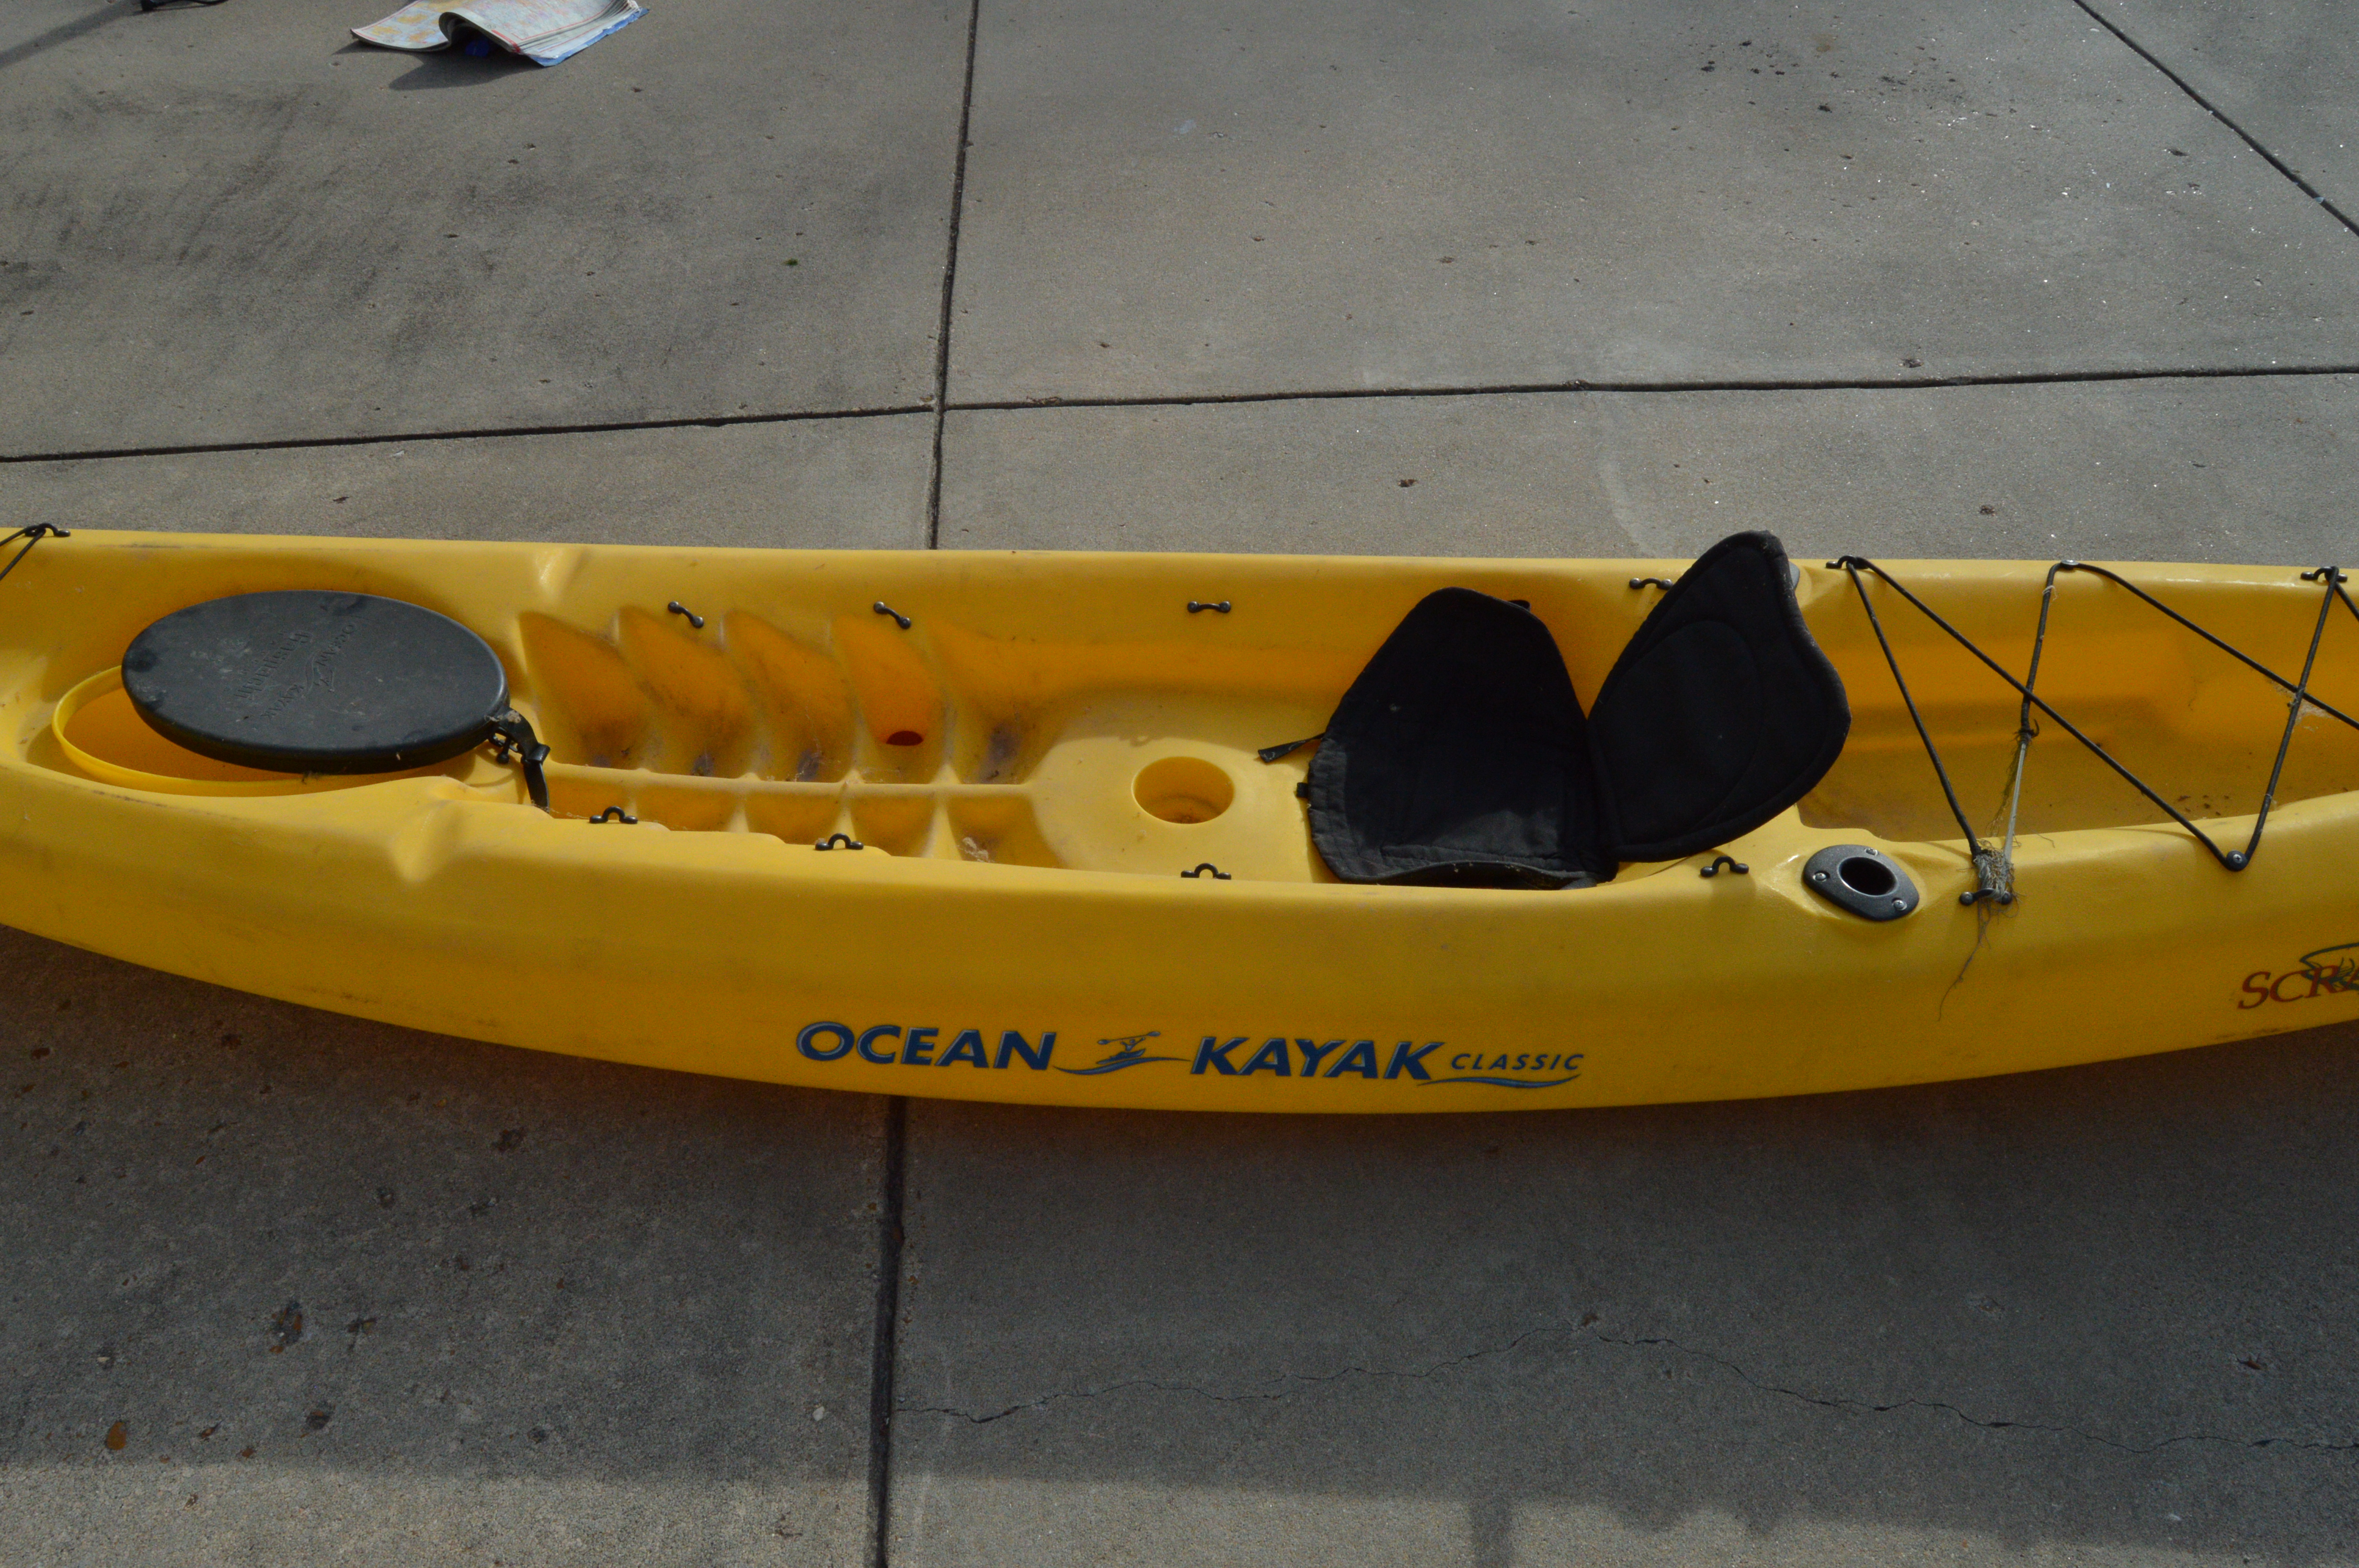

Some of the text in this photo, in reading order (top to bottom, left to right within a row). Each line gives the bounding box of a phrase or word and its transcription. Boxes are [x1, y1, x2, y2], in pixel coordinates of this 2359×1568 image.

[2238, 964, 2359, 1009] SCR
[796, 1021, 1585, 1080] OCEAN KAYAK CLASSIC
